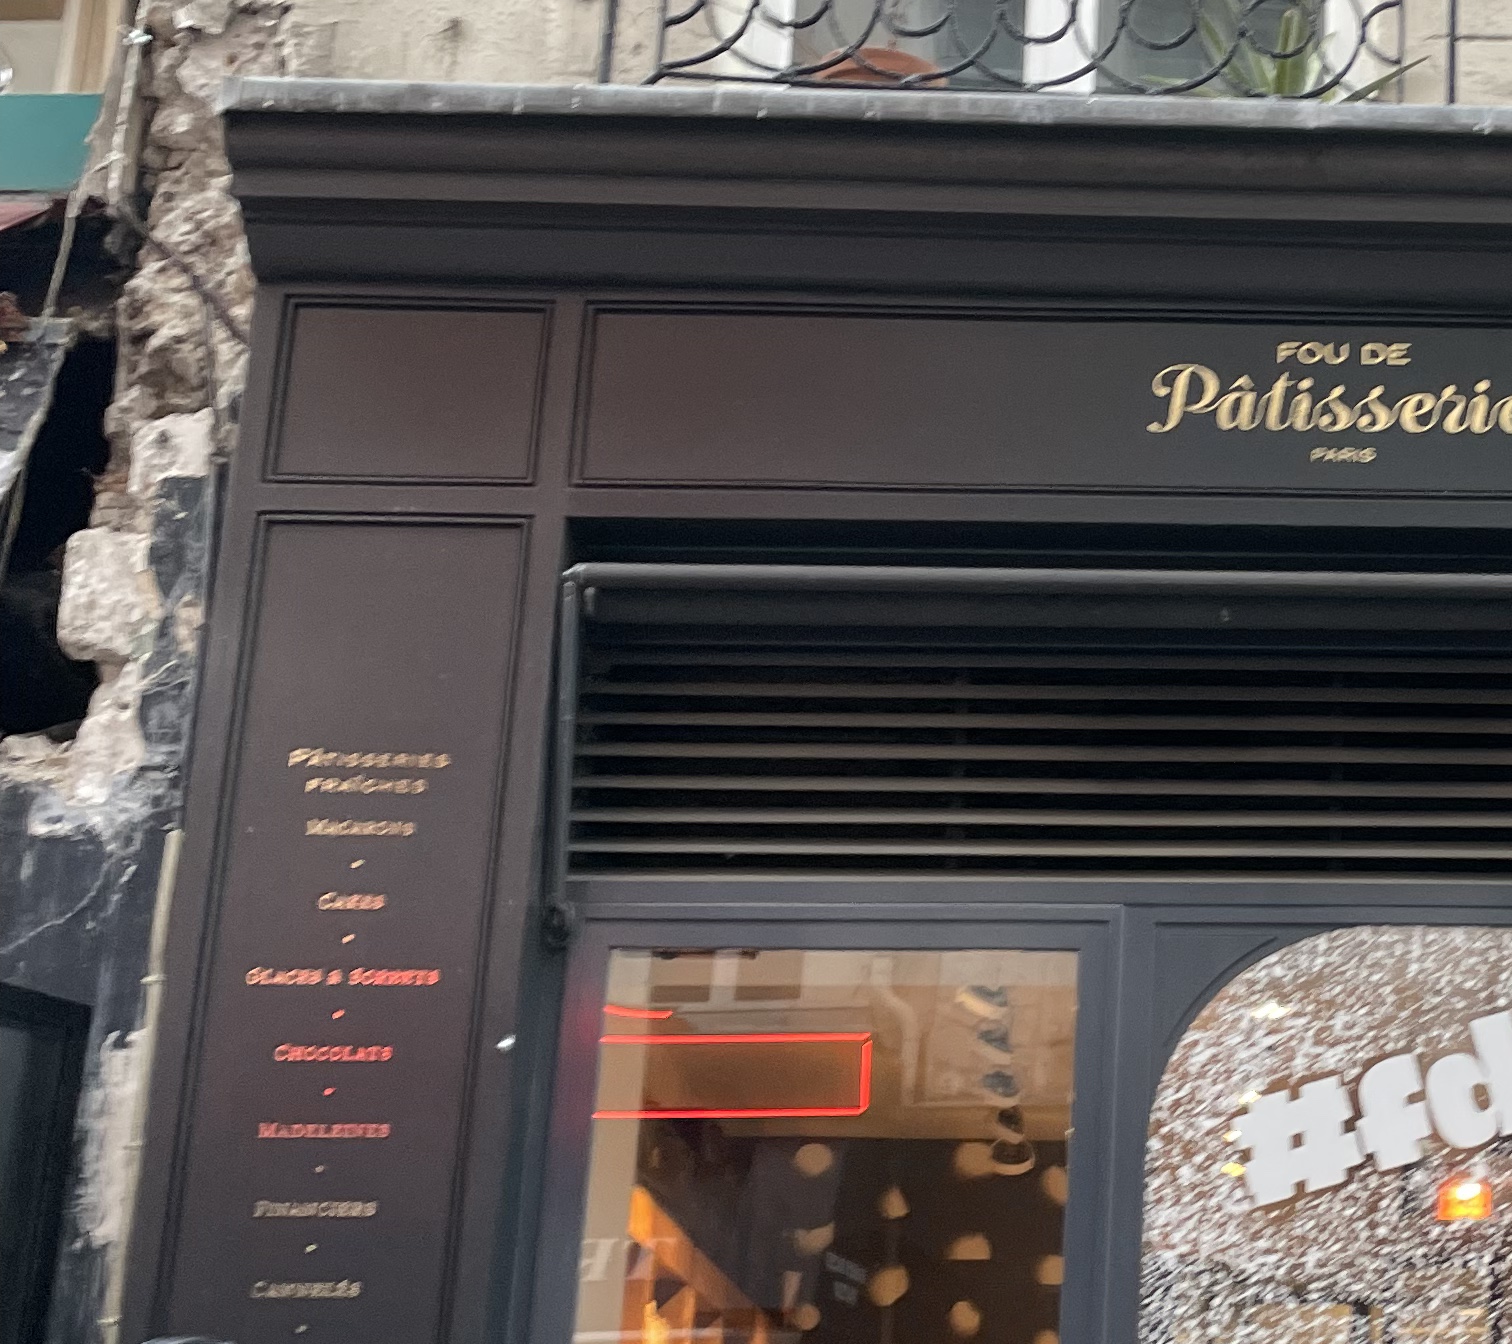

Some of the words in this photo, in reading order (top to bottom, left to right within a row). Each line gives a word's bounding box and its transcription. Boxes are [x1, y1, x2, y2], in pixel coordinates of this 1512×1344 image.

[1276, 341, 1350, 365] FOU
[1360, 342, 1412, 366] DE
[1310, 447, 1377, 463] PARIS
[273, 1043, 394, 1062] CHOCOLATS
[257, 1122, 391, 1139] MADELEINES
